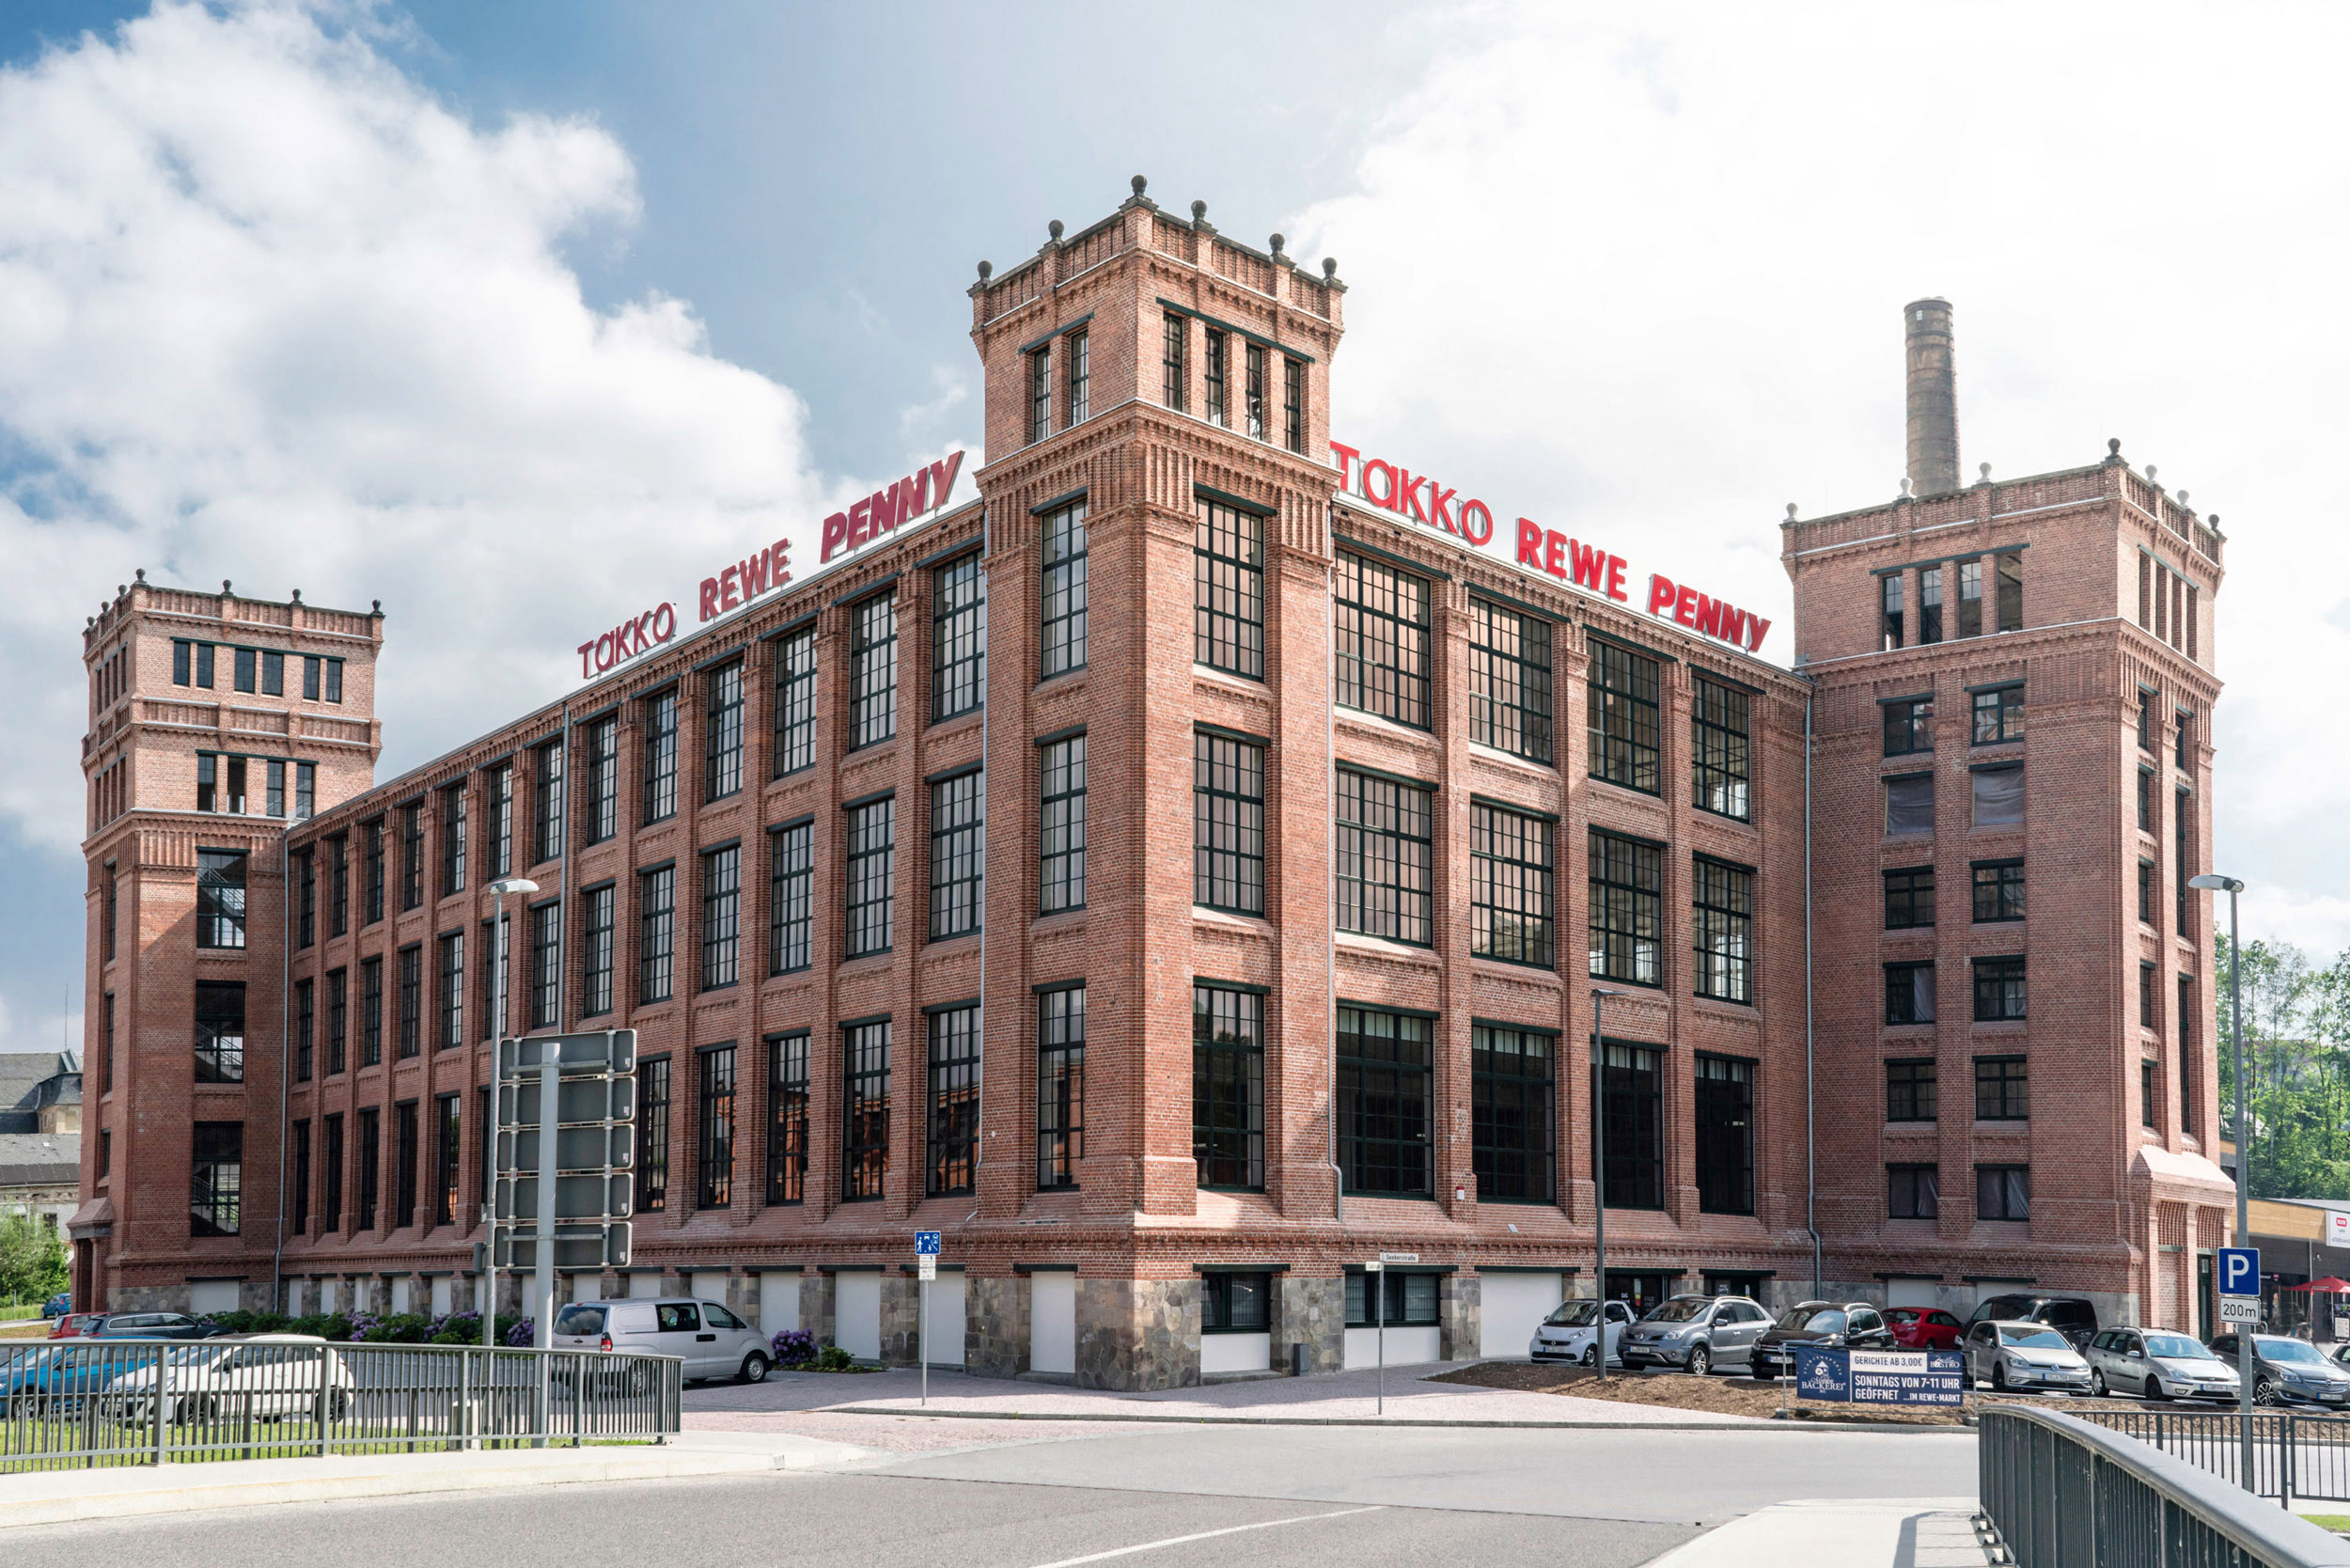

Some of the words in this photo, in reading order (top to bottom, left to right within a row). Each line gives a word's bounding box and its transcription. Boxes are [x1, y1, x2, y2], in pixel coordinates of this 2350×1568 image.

[699, 538, 791, 622] REWE
[820, 449, 965, 564] PENNY
[1516, 516, 1629, 603] REWE
[1648, 572, 1772, 652] PENNY
[2227, 1253, 2250, 1289] P
[1855, 1356, 1888, 1365] GERICHTE
[1889, 1356, 1900, 1365] AB
[1901, 1357, 1923, 1367] 3,00€
[1855, 1374, 1900, 1388] SONNTAGS
[1901, 1376, 1919, 1388] VON
[1920, 1377, 1939, 1388] 7-11
[1941, 1377, 1960, 1389] UHR
[1855, 1387, 1899, 1400] GEÖFFNET
[1919, 1393, 1961, 1403] REWE-MARKT
